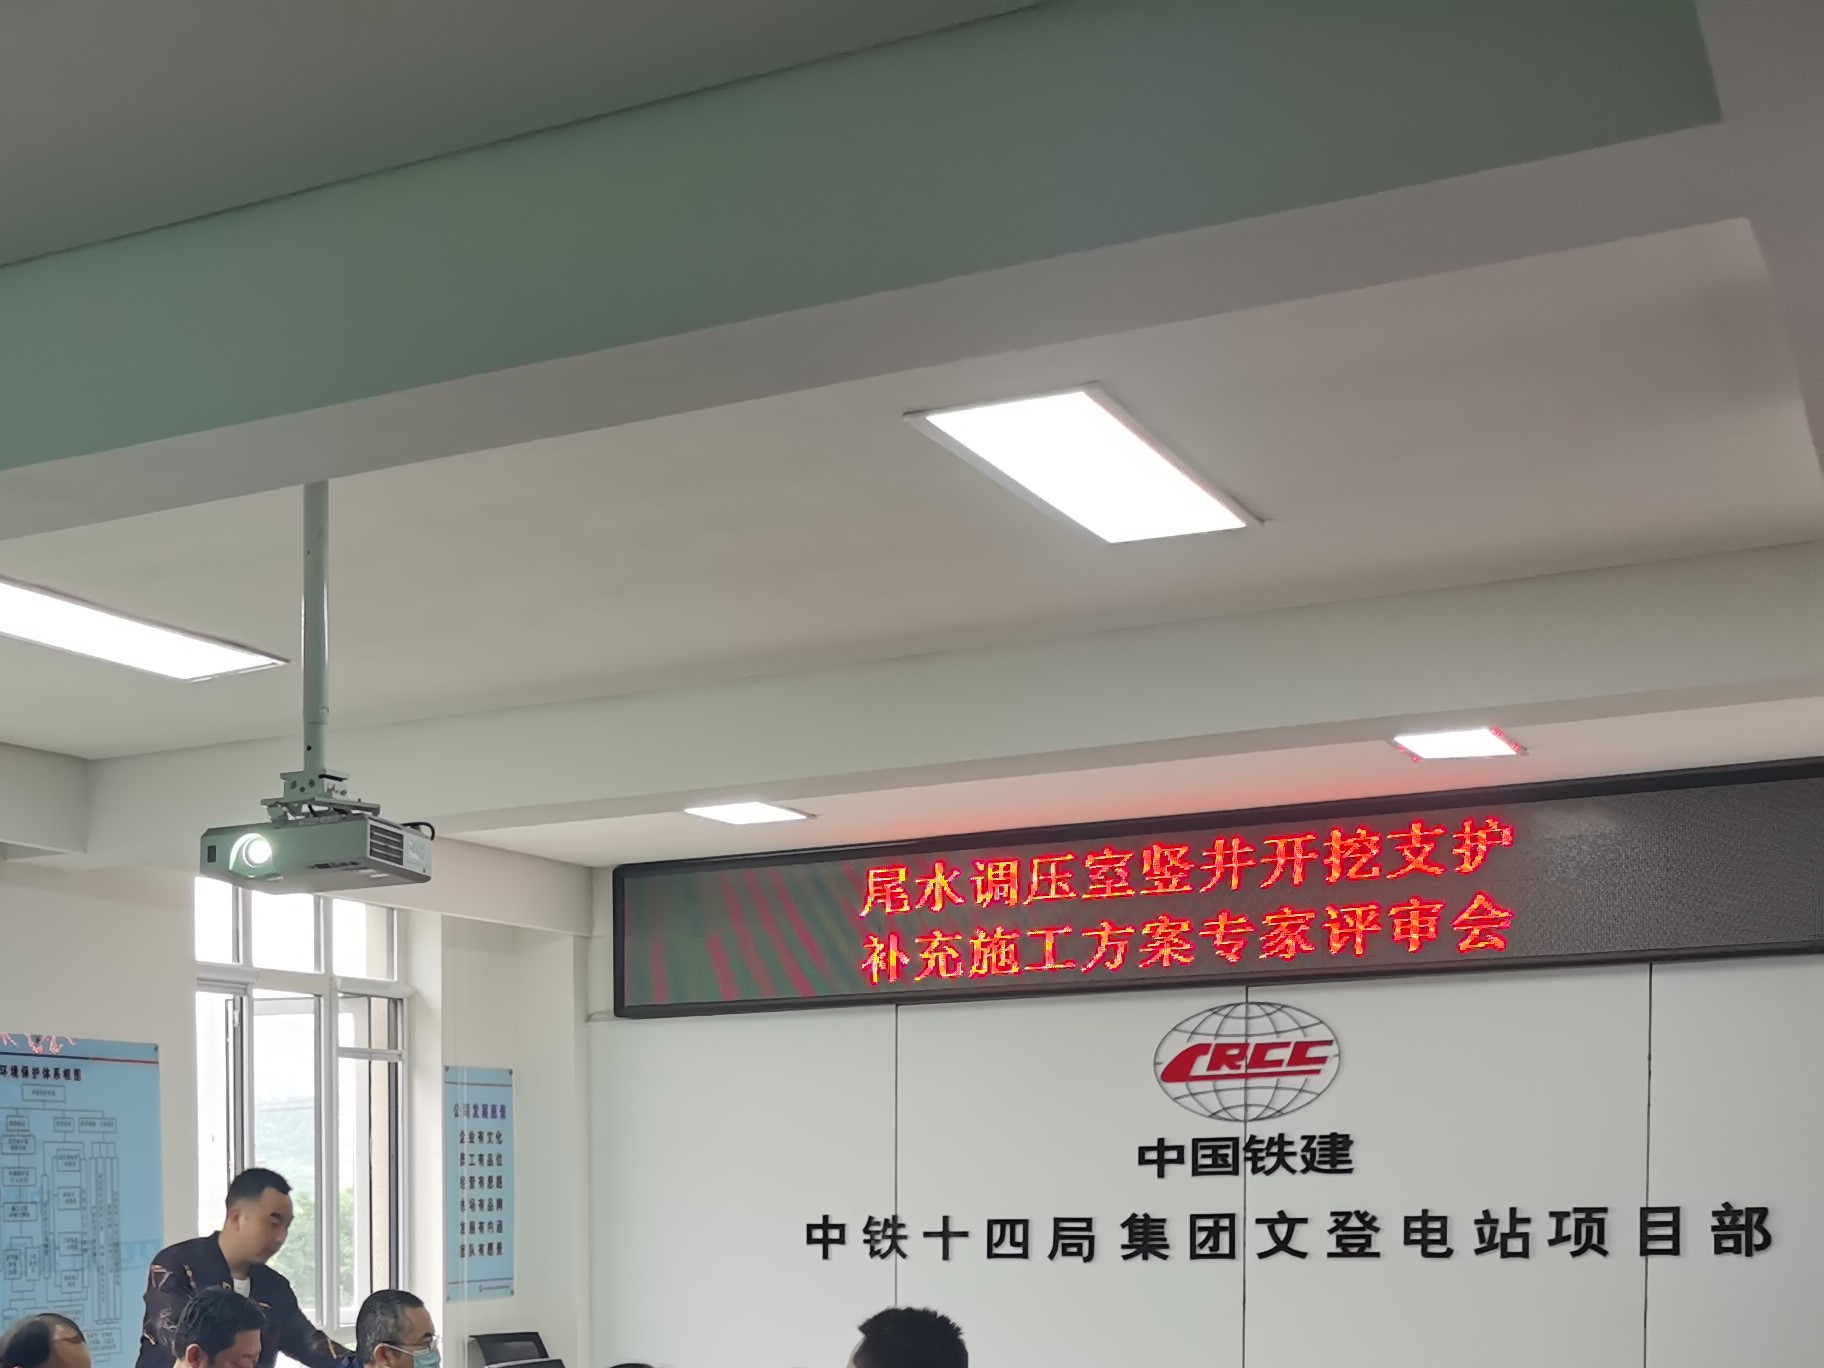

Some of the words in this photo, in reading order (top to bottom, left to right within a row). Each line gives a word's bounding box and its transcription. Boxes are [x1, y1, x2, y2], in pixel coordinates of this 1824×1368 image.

[860, 816, 1516, 918] 尾水调压室竖井开挖支护
[861, 893, 1516, 986] 补充施工方案专家评审会
[0, 1064, 82, 1082] 环境保护体系框图
[1160, 1039, 1334, 1083] CRCC
[1137, 1132, 1355, 1178] 中国铁建
[805, 1202, 1773, 1264] 中铁十四局集团文登电站项目部
